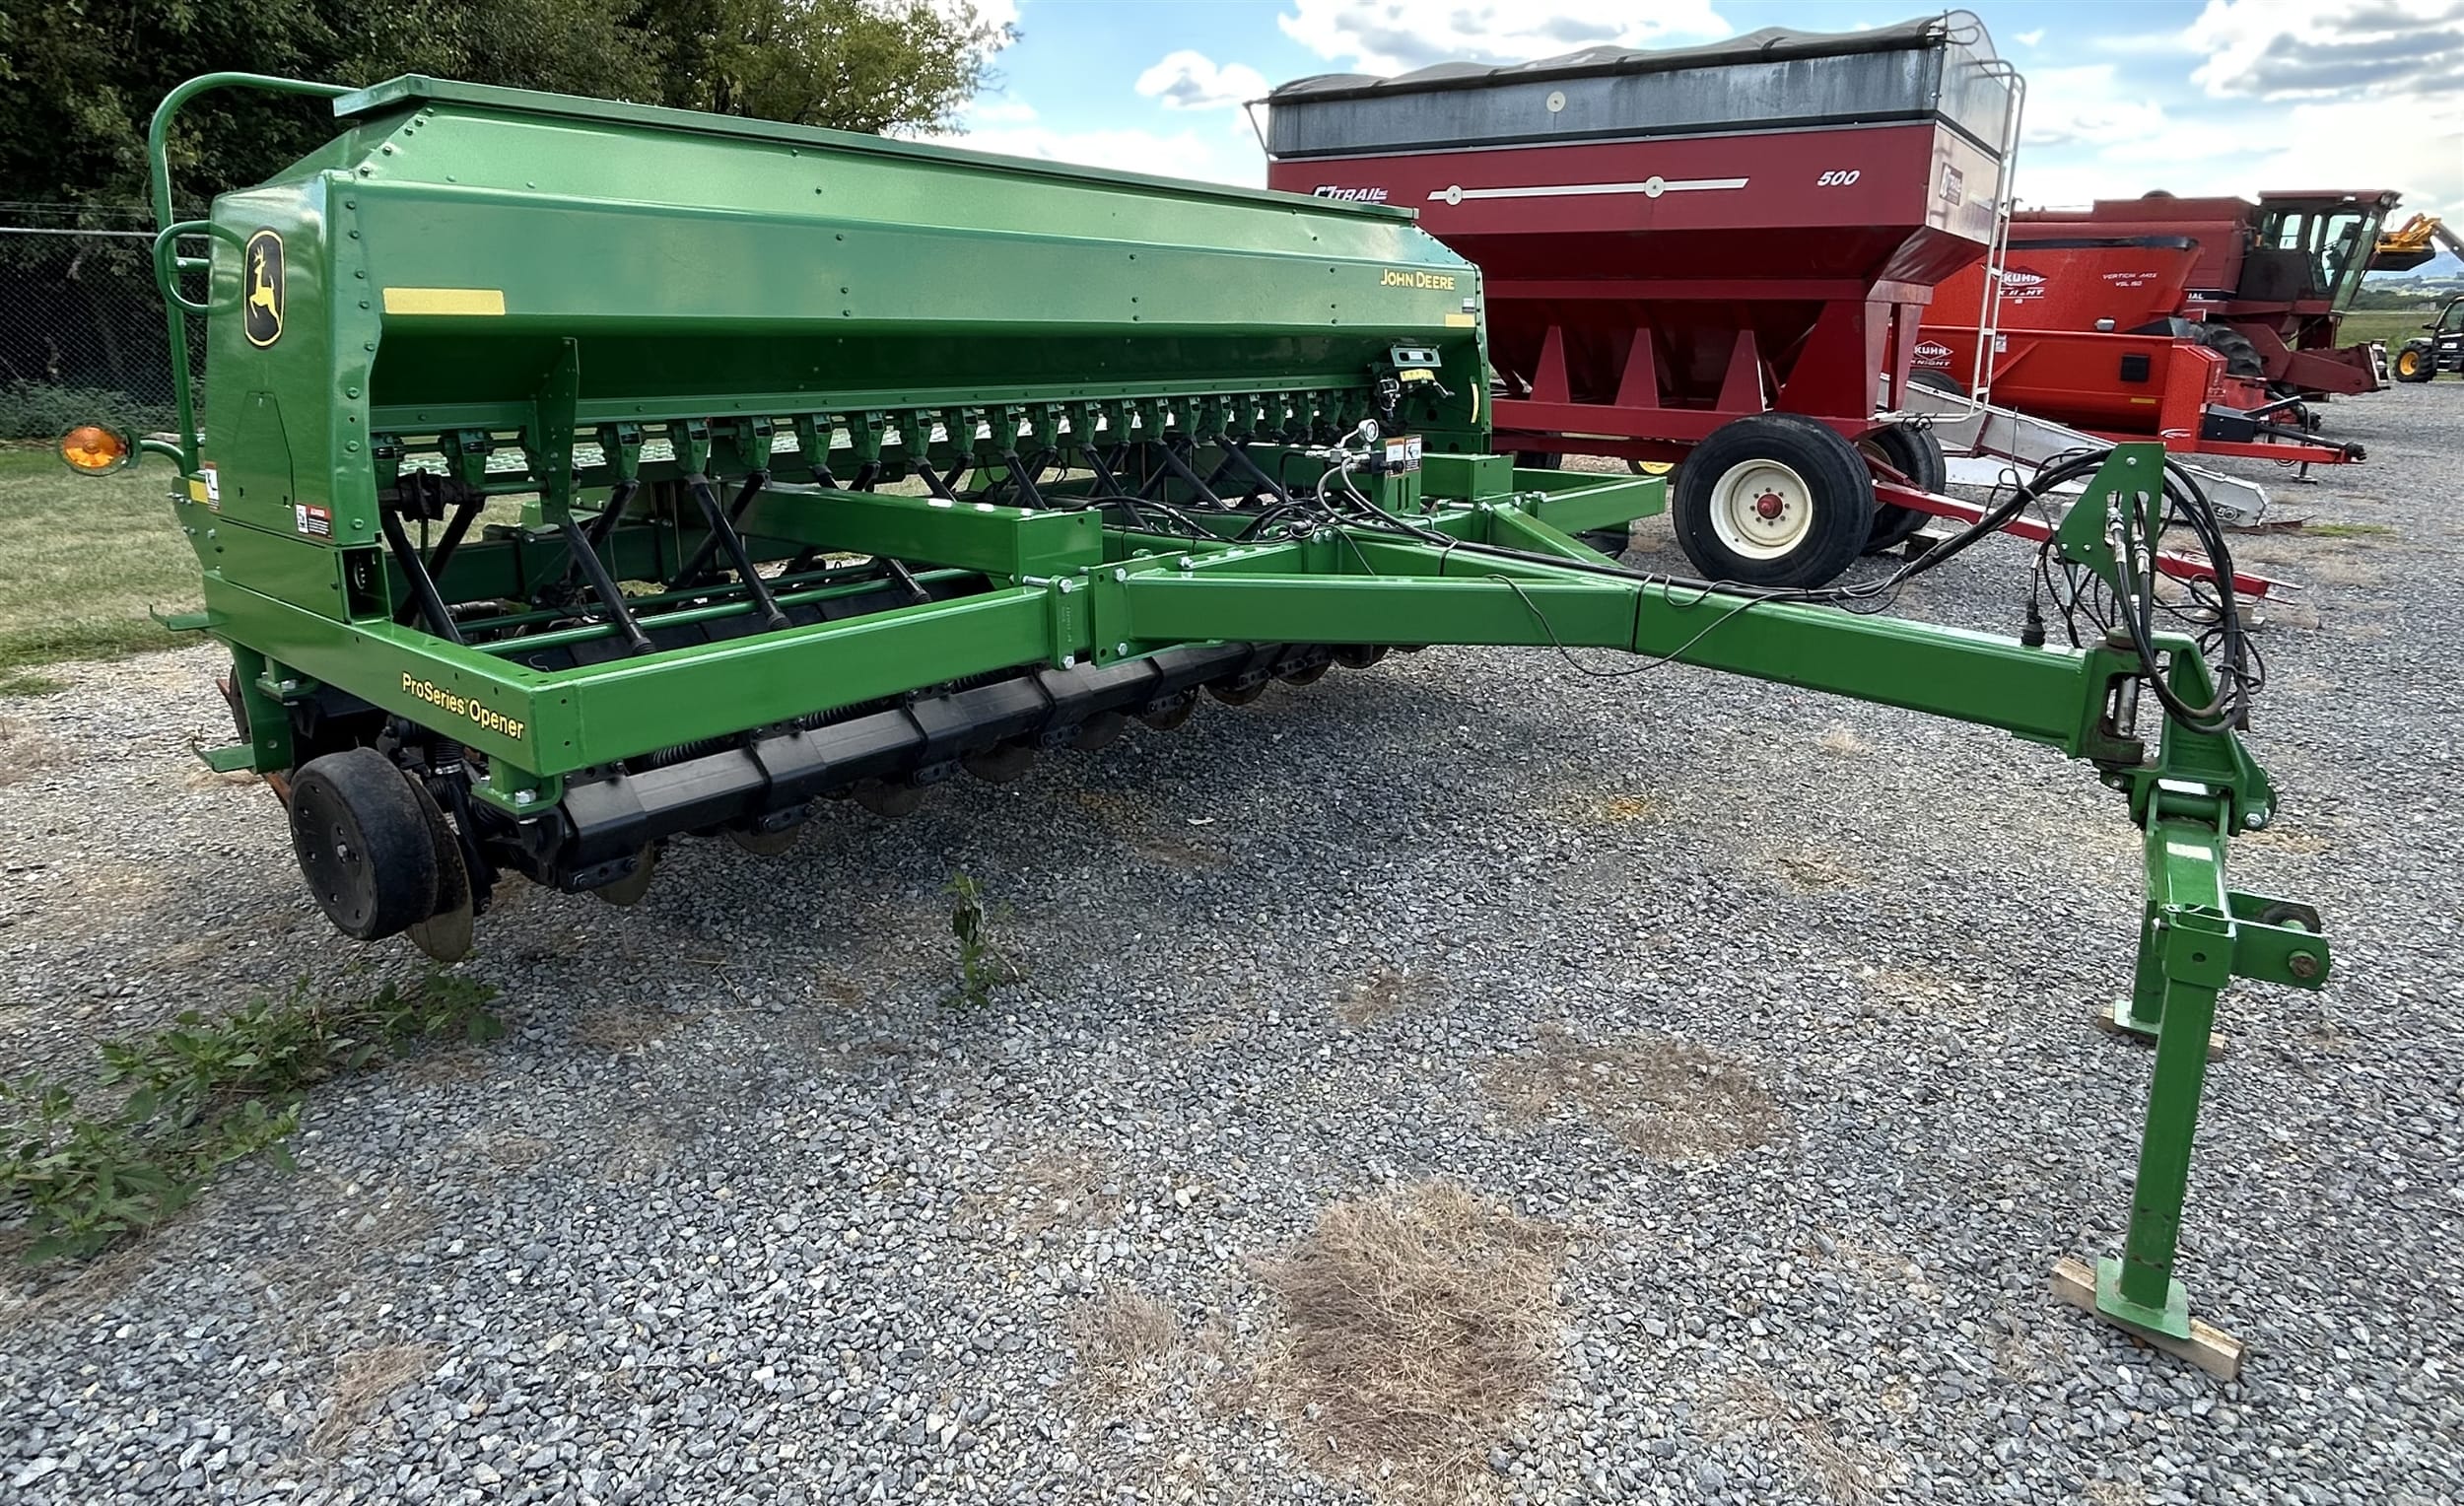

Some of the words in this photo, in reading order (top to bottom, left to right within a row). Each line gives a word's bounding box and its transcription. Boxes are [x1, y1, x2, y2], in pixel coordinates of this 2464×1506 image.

[1816, 170, 1861, 186] 500
[1380, 268, 1413, 287] JOHN
[1416, 271, 1455, 290] DEERE
[2004, 271, 2040, 283] KUHN
[1914, 346, 1947, 355] KUHN
[401, 672, 465, 716] ProSeries
[469, 700, 524, 739] Opener
